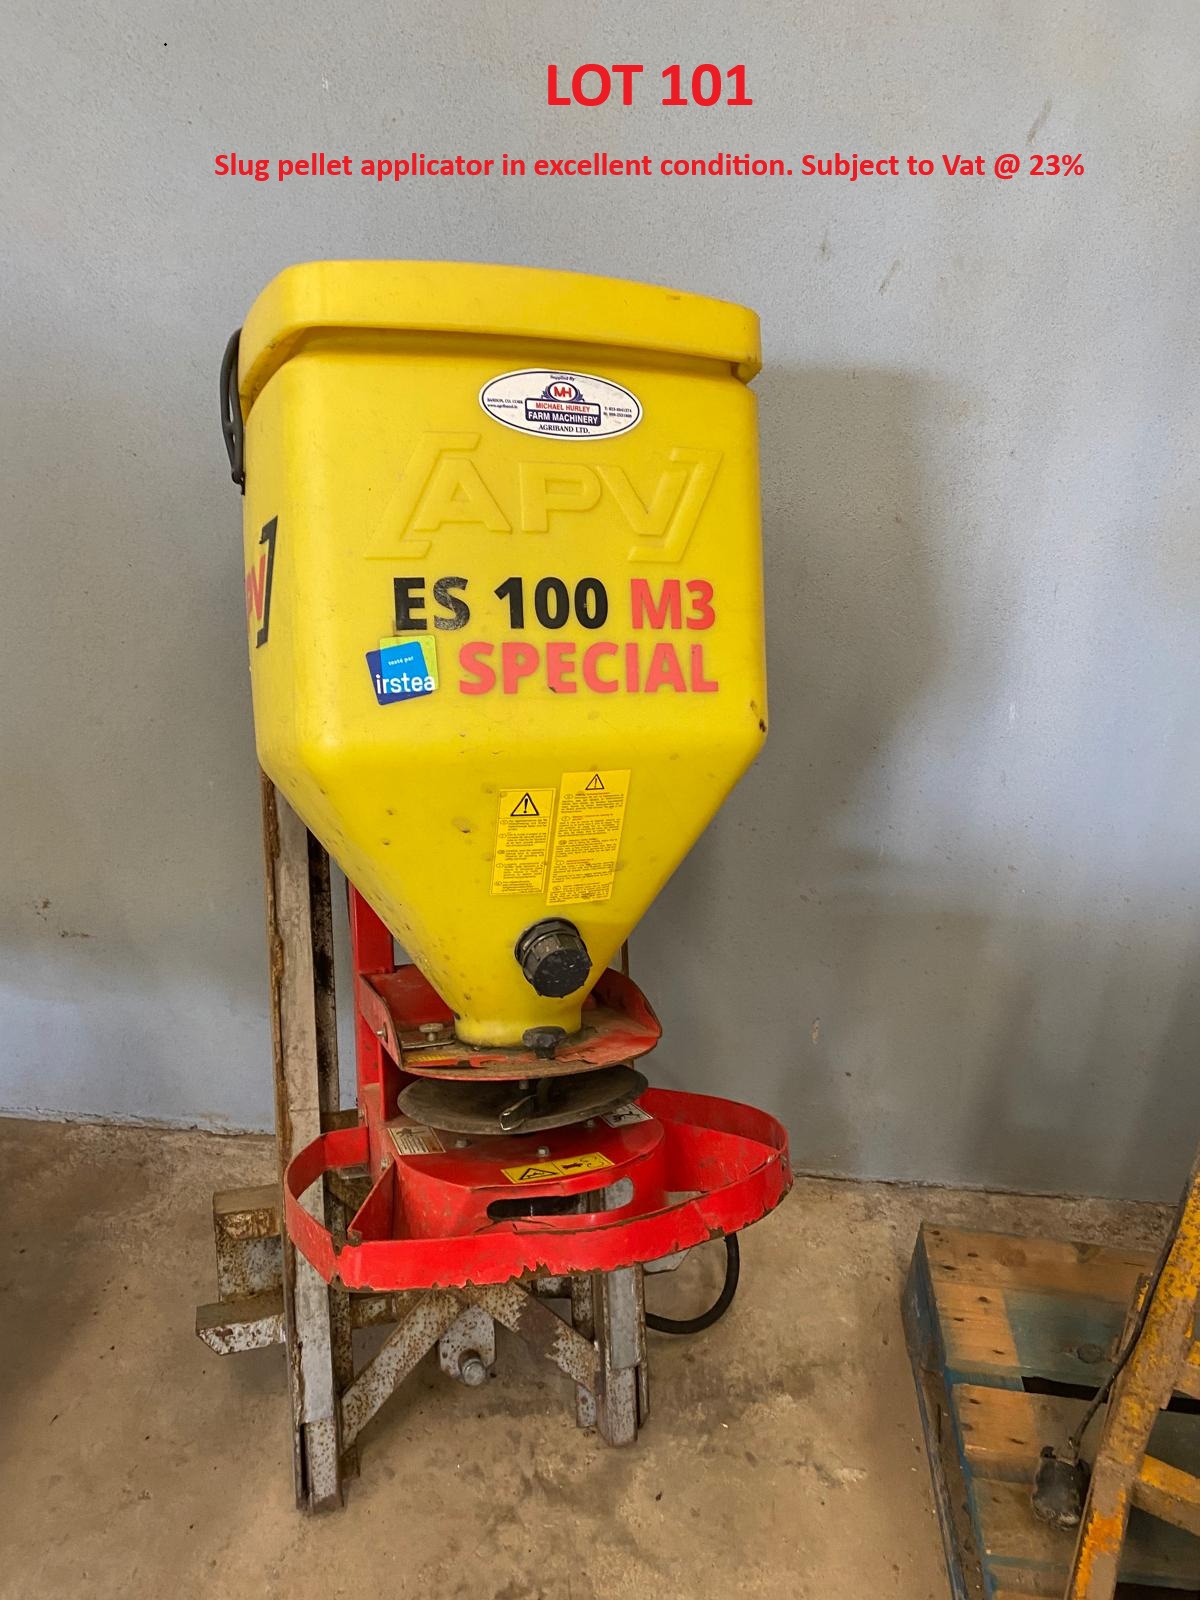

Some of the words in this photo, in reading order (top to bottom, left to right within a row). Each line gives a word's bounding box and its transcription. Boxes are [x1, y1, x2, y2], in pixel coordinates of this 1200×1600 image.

[554, 386, 572, 398] MH
[535, 402, 564, 410] MICHAEL
[566, 404, 590, 412] HURLEY
[528, 411, 551, 421] FARM
[552, 413, 598, 425] MACHINERY
[539, 424, 574, 432] AGRIBAND
[575, 426, 591, 434] LTD.
[393, 576, 471, 631] ES
[493, 577, 609, 630] 100
[630, 578, 716, 631] M3
[458, 641, 719, 696] SPECIAL
[375, 672, 436, 694] irstea
